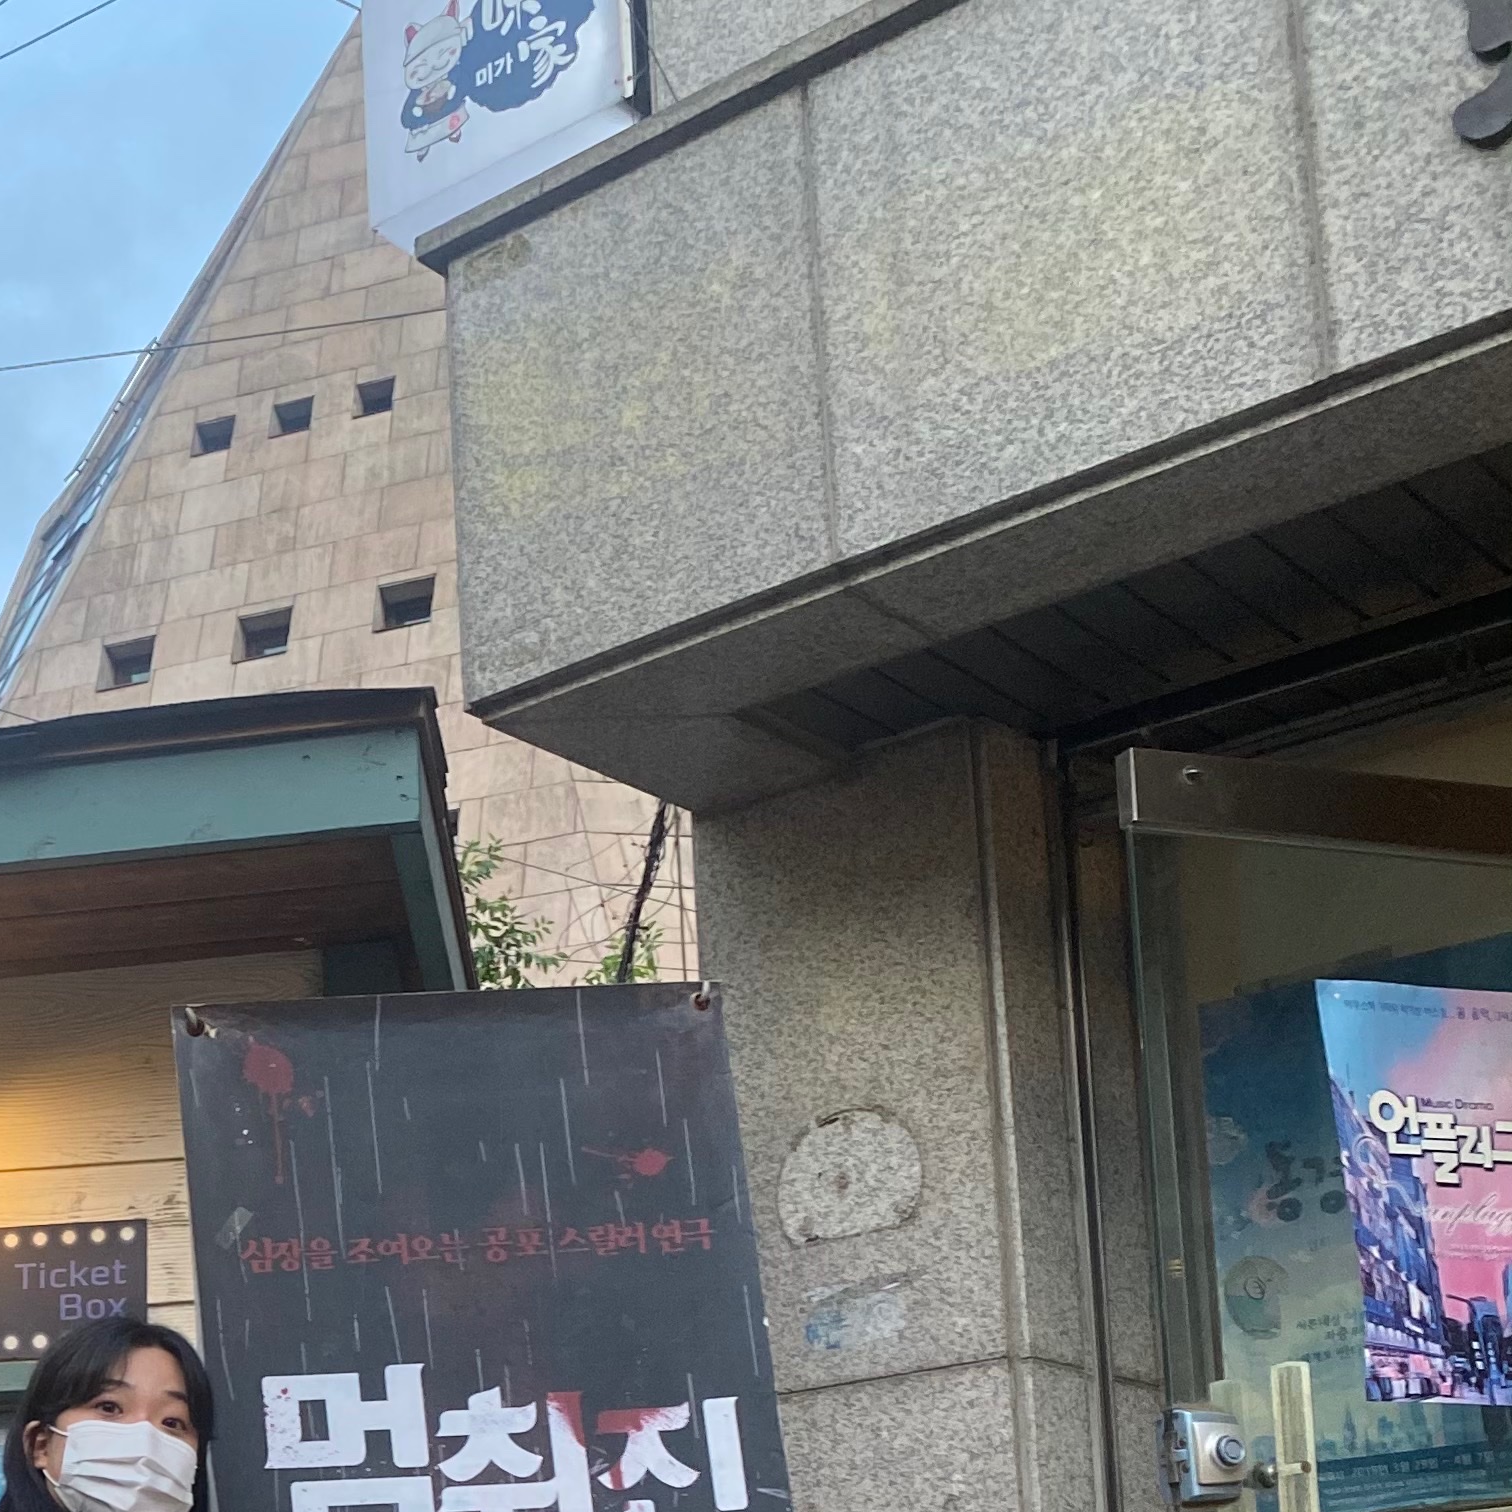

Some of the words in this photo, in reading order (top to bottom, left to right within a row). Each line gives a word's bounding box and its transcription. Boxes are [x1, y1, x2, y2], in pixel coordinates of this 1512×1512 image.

[475, 51, 514, 87] 미가
[1454, 1098, 1494, 1111] Drama
[240, 1235, 338, 1274] 심장을
[345, 1232, 470, 1266] 조여오는
[477, 1226, 549, 1263] 공포
[558, 1221, 648, 1255] 스릴러
[651, 1216, 718, 1254] 연극
[14, 1258, 127, 1291] Ticket
[59, 1292, 127, 1321] Box
